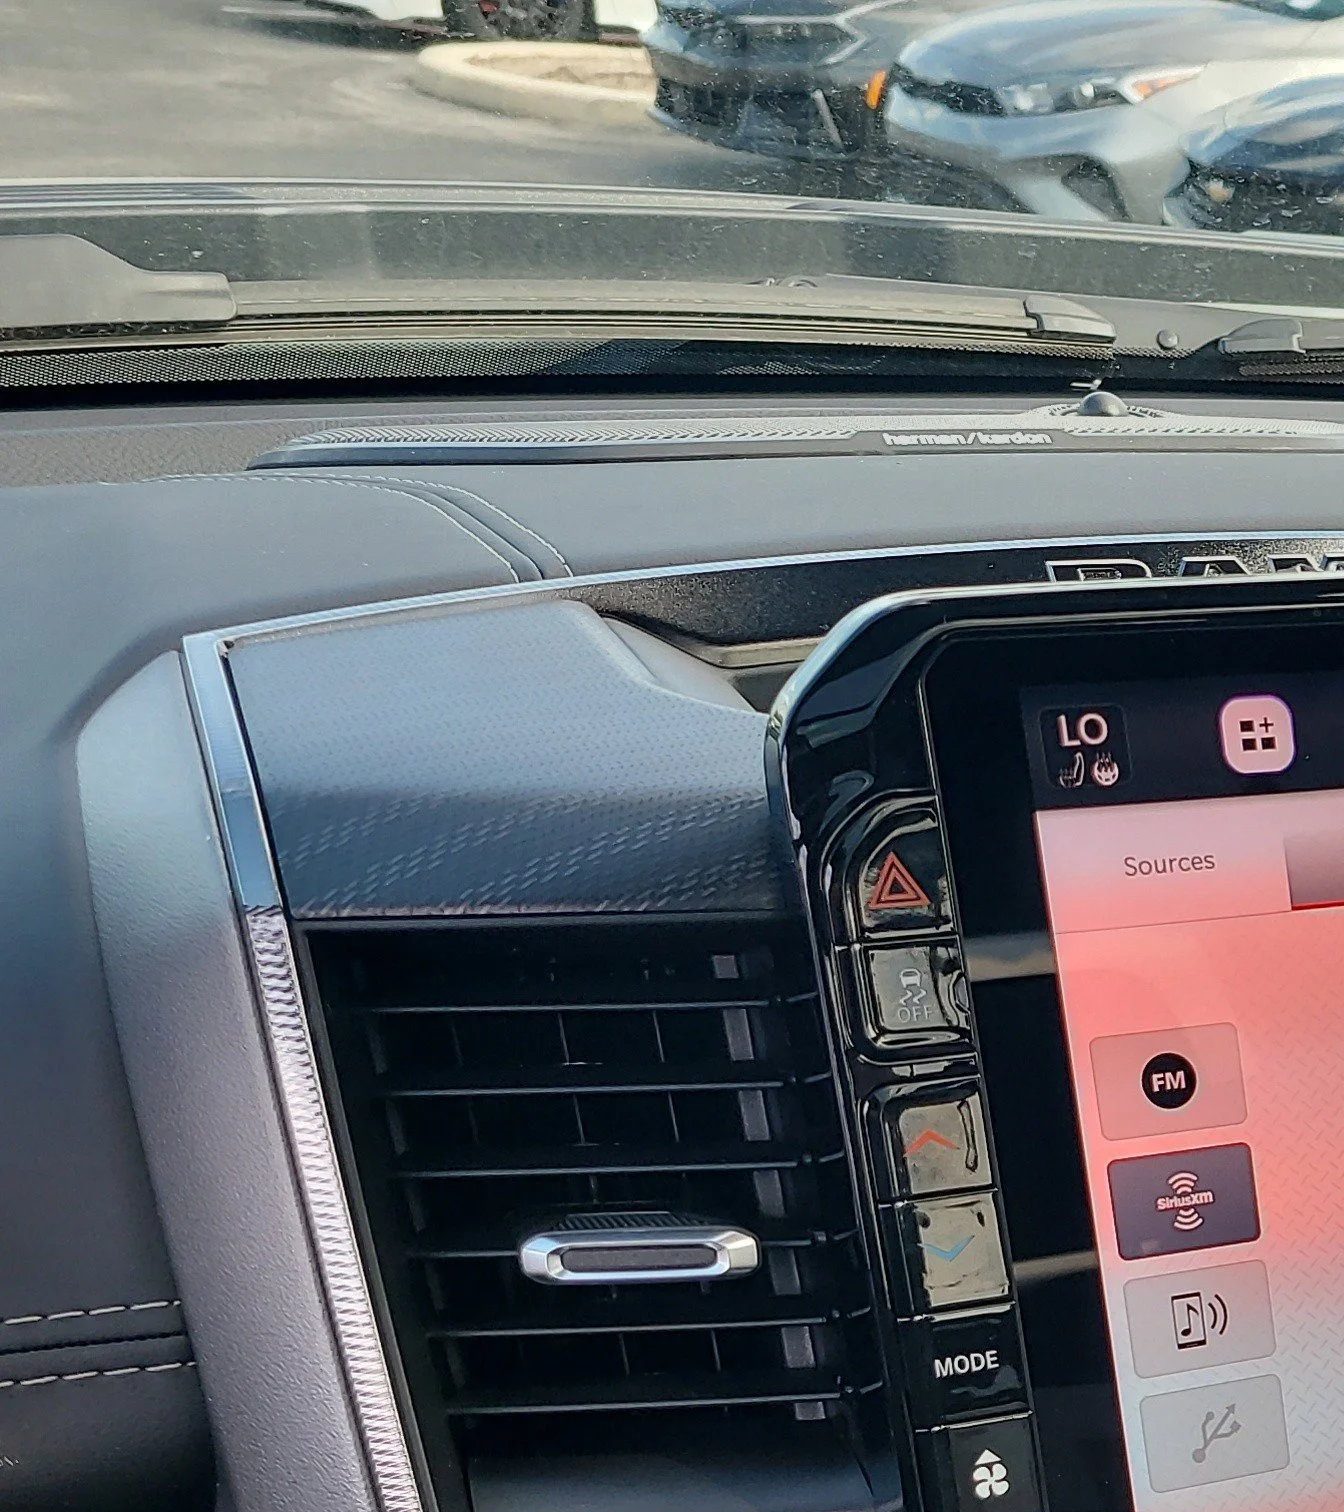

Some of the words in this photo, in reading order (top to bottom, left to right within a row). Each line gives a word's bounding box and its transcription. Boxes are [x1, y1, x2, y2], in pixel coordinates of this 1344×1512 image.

[882, 431, 1054, 446] harman/kardon
[1056, 711, 1109, 748] LO
[1123, 851, 1216, 878] Sources
[896, 1007, 932, 1023] OFF
[1152, 1070, 1187, 1092] FM
[933, 1349, 1001, 1378] MODE
